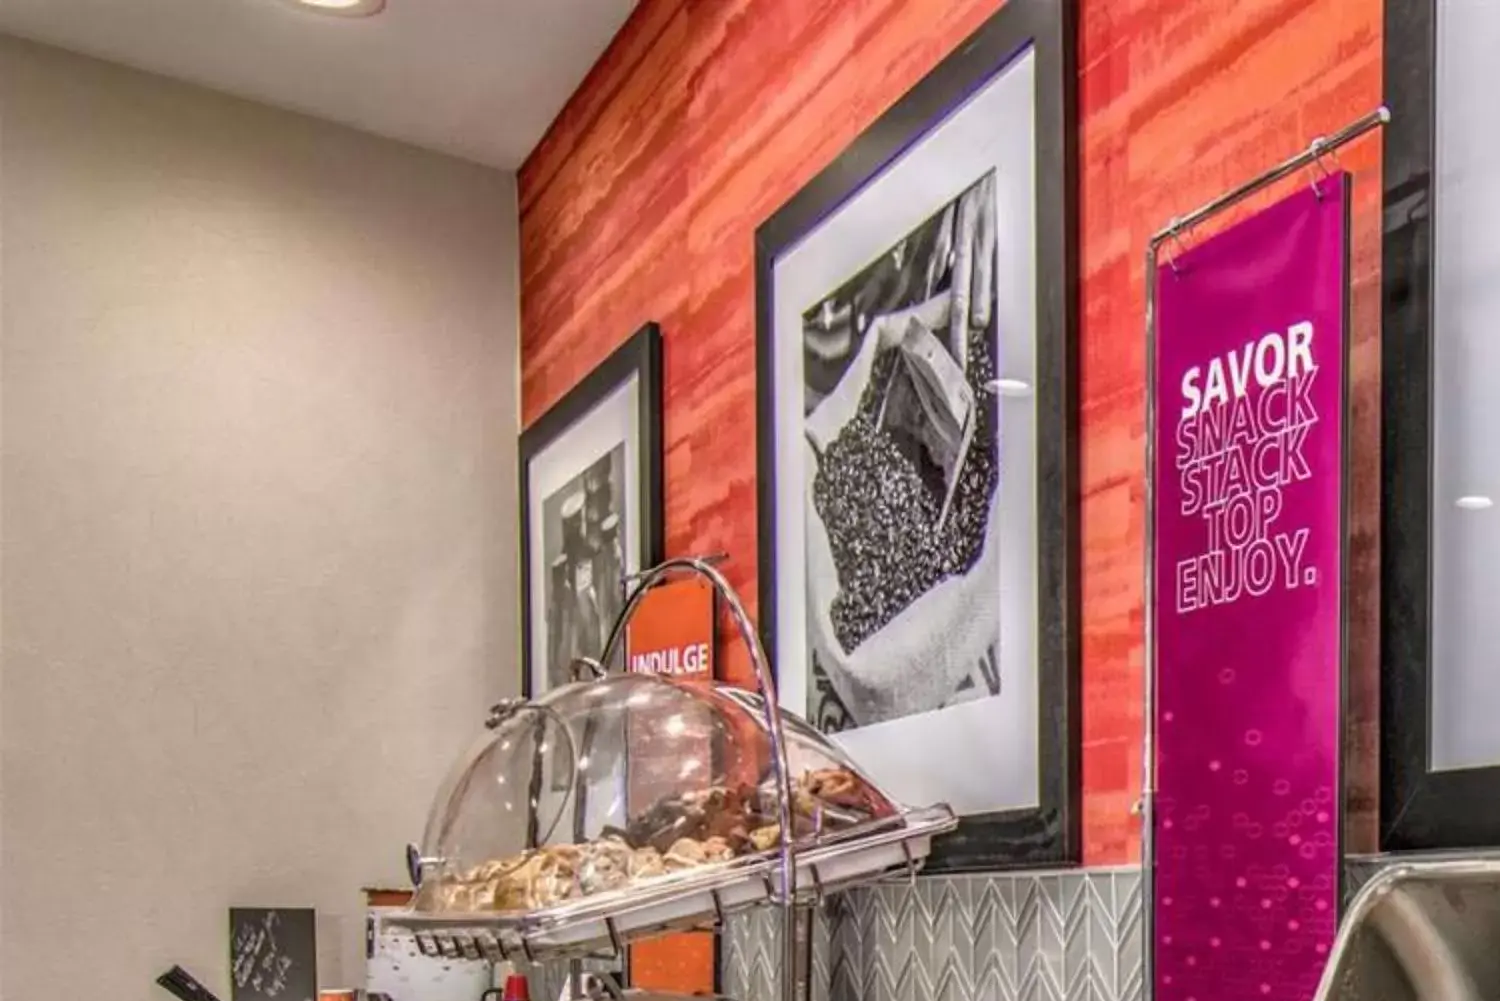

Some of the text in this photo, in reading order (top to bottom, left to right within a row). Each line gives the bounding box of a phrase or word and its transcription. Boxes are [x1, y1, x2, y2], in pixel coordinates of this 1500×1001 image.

[1182, 320, 1316, 417] SAVOR
[1177, 366, 1319, 468] SNACK
[1181, 425, 1310, 515] STACK
[1204, 486, 1282, 552] TOP
[1177, 529, 1319, 614] ENJOY.
[632, 643, 708, 675] INDULGE
